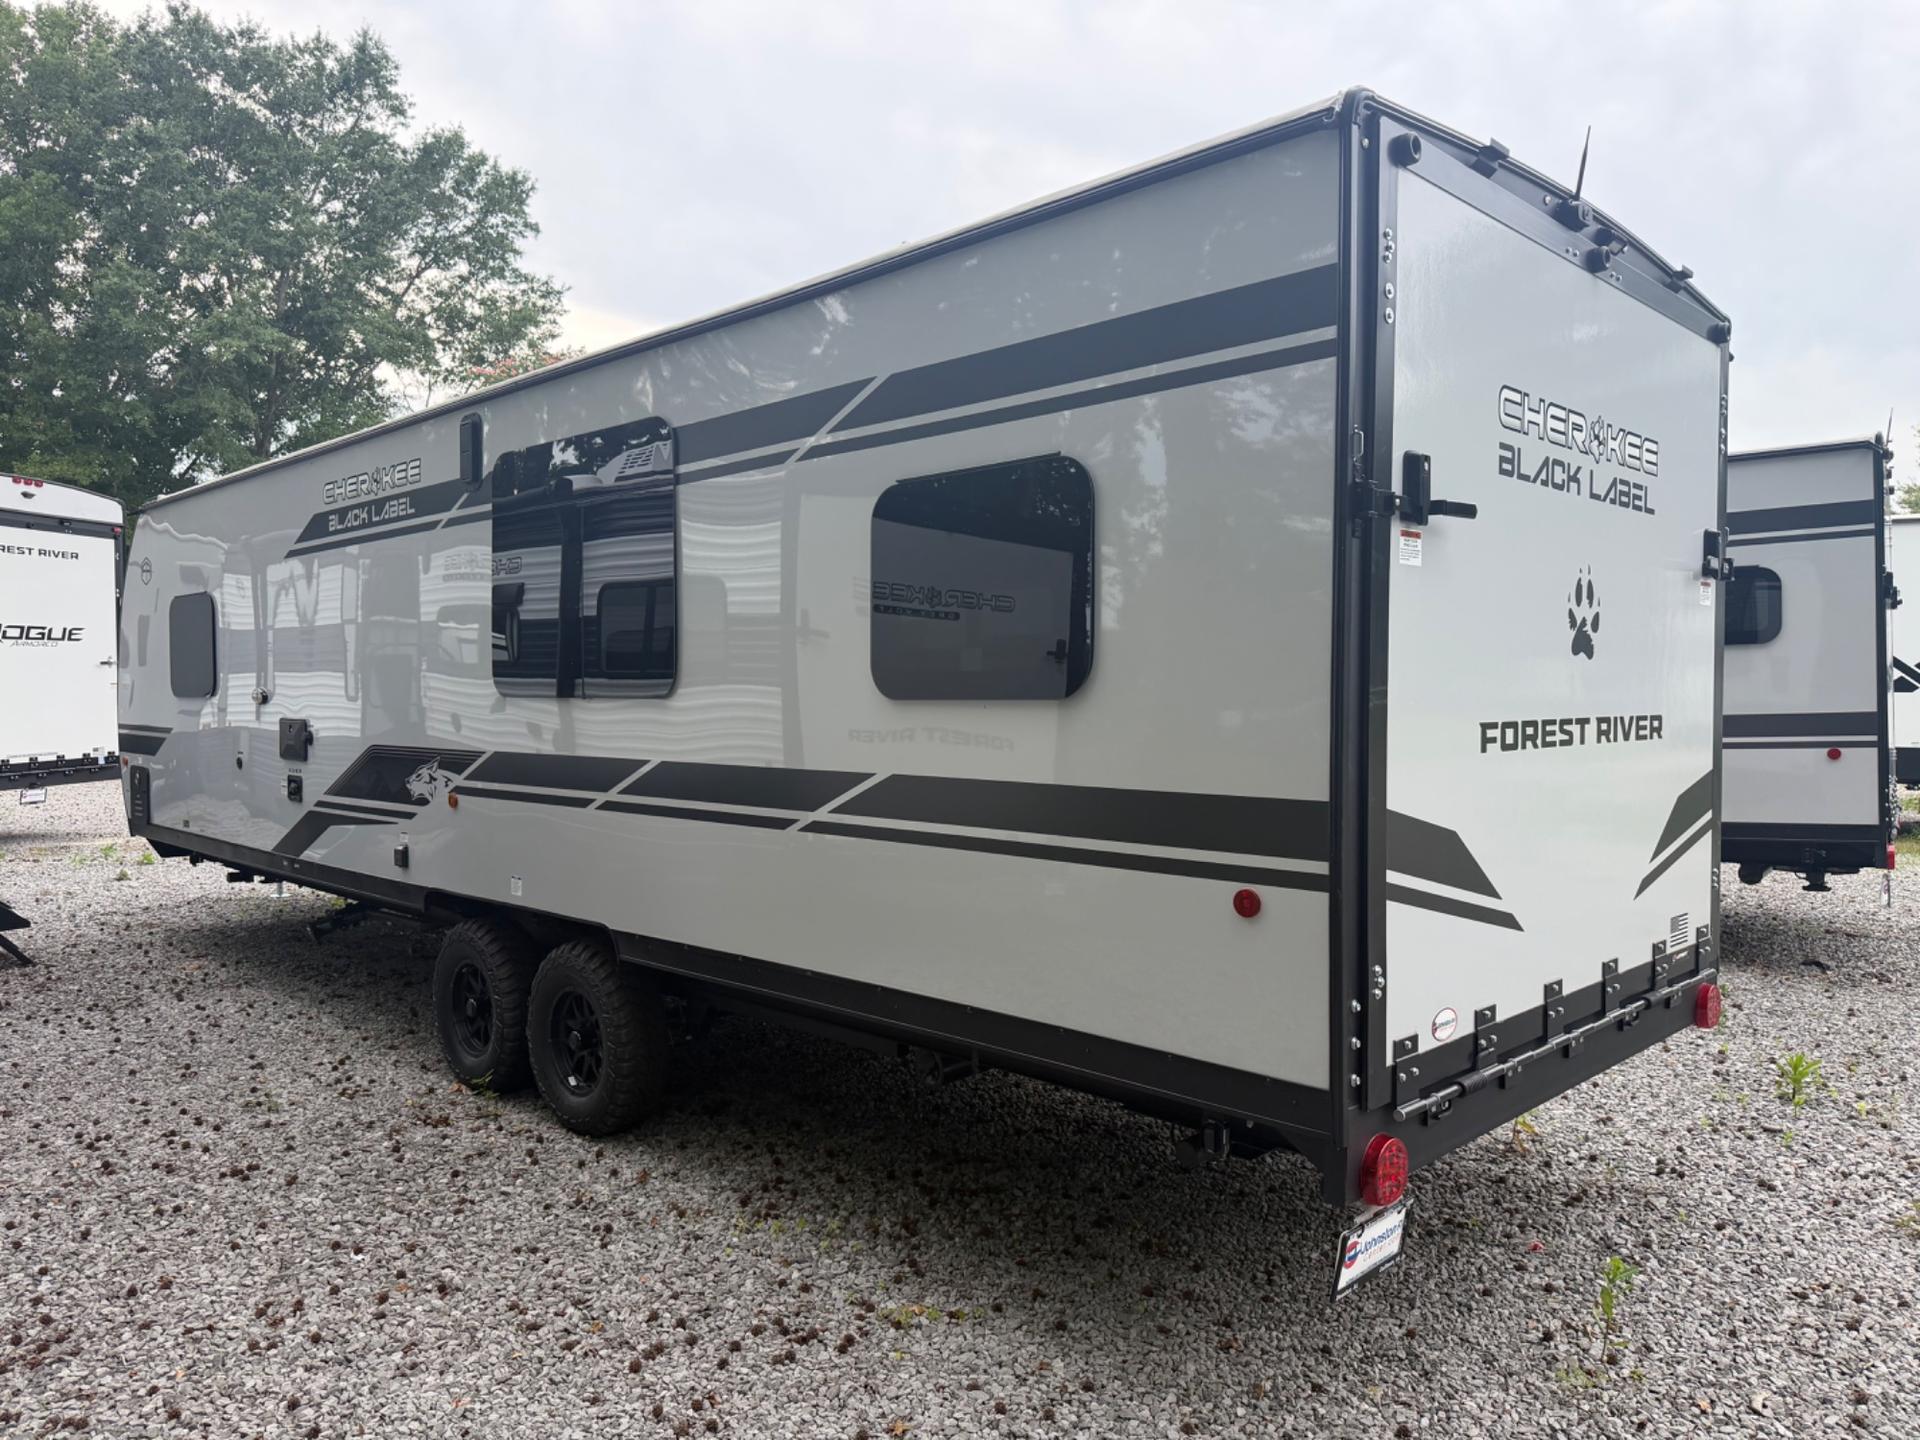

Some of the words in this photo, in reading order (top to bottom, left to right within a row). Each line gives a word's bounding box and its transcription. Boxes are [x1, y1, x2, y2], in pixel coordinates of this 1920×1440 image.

[1498, 384, 1659, 477] CHEROKEE
[323, 458, 421, 504] CHEROKEE
[1498, 441, 1582, 496] BLACK
[1589, 469, 1655, 515] LABEL
[328, 506, 368, 532] BLACK
[372, 496, 415, 522] LABEL
[38, 548, 79, 560] RIVER
[0, 622, 86, 642] OGUE
[1479, 717, 1591, 754] FOREST
[1595, 714, 1663, 745] RIVER
